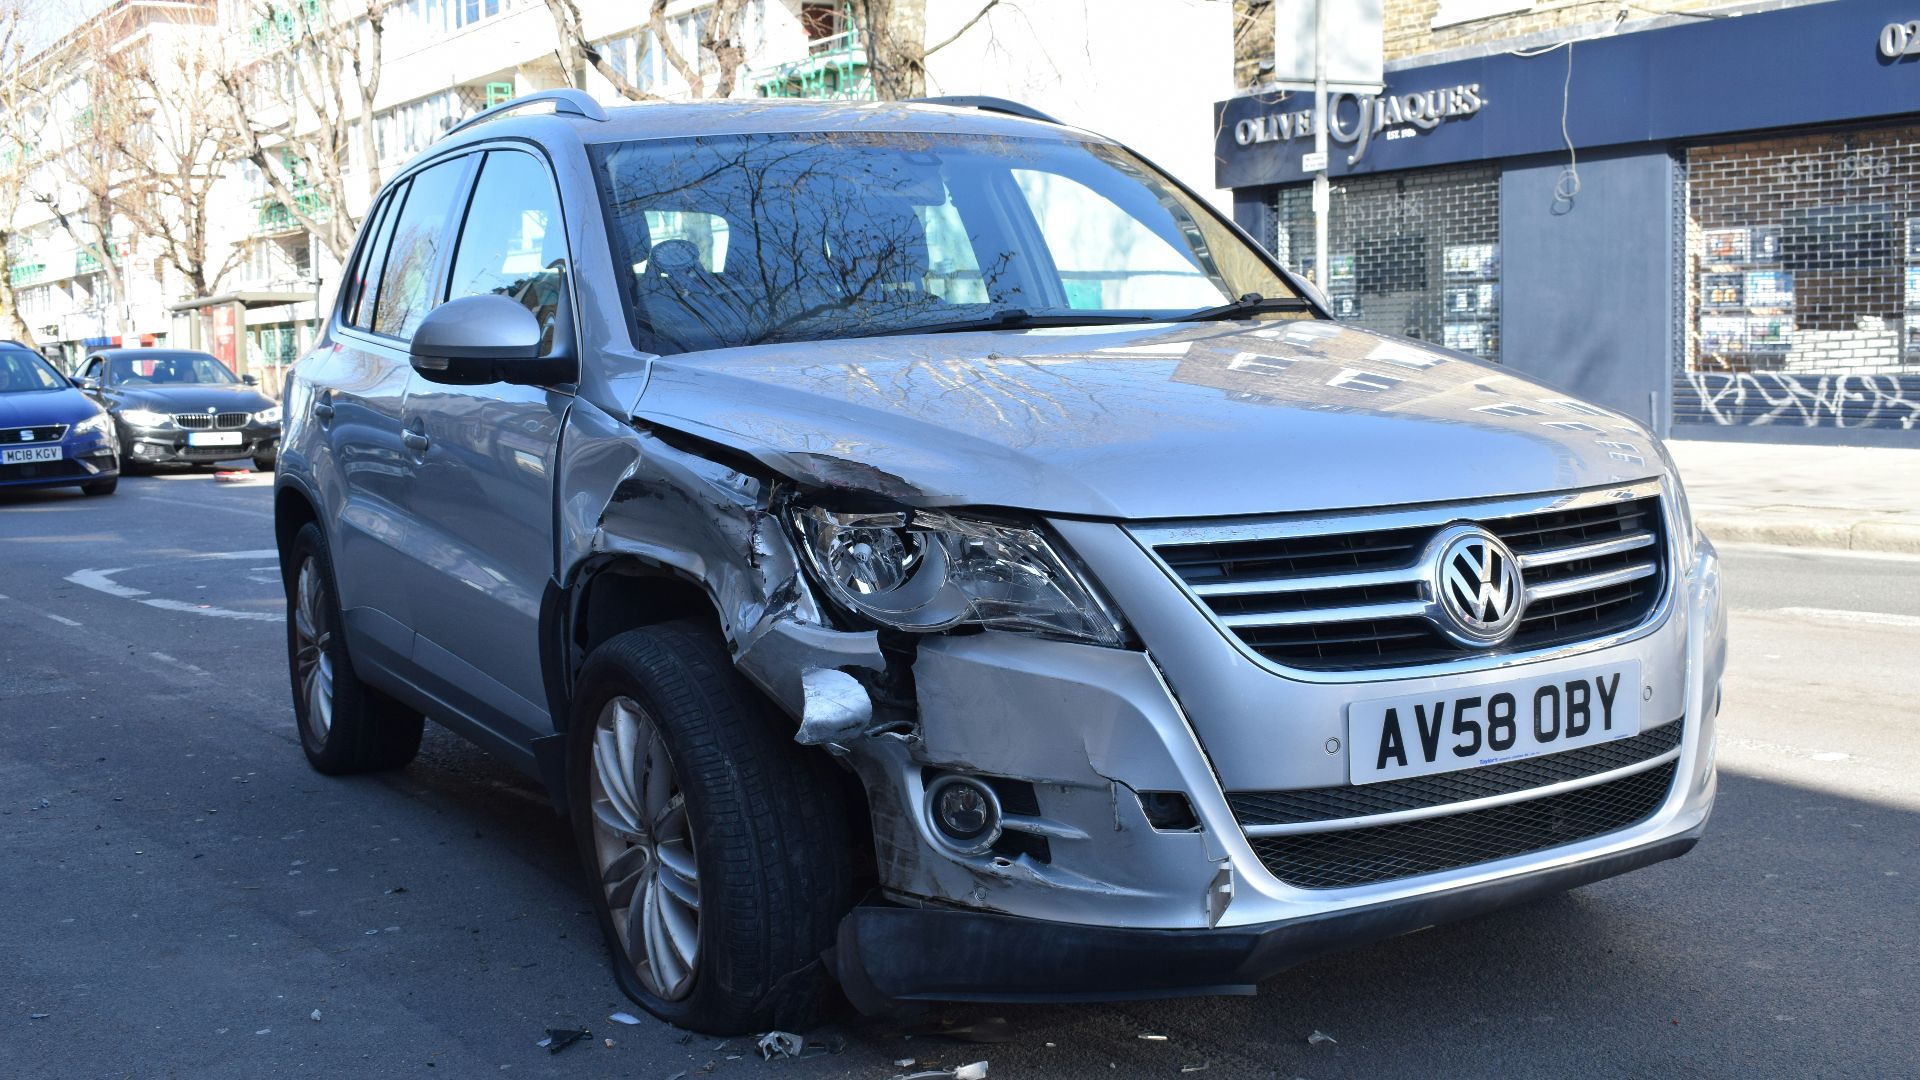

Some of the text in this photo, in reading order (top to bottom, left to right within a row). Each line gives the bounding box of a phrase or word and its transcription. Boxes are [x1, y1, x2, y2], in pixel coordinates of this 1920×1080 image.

[1372, 83, 1482, 133] JAQUES
[7, 448, 57, 461] MC18 KGV
[1376, 672, 1621, 770] AV58 OBY
